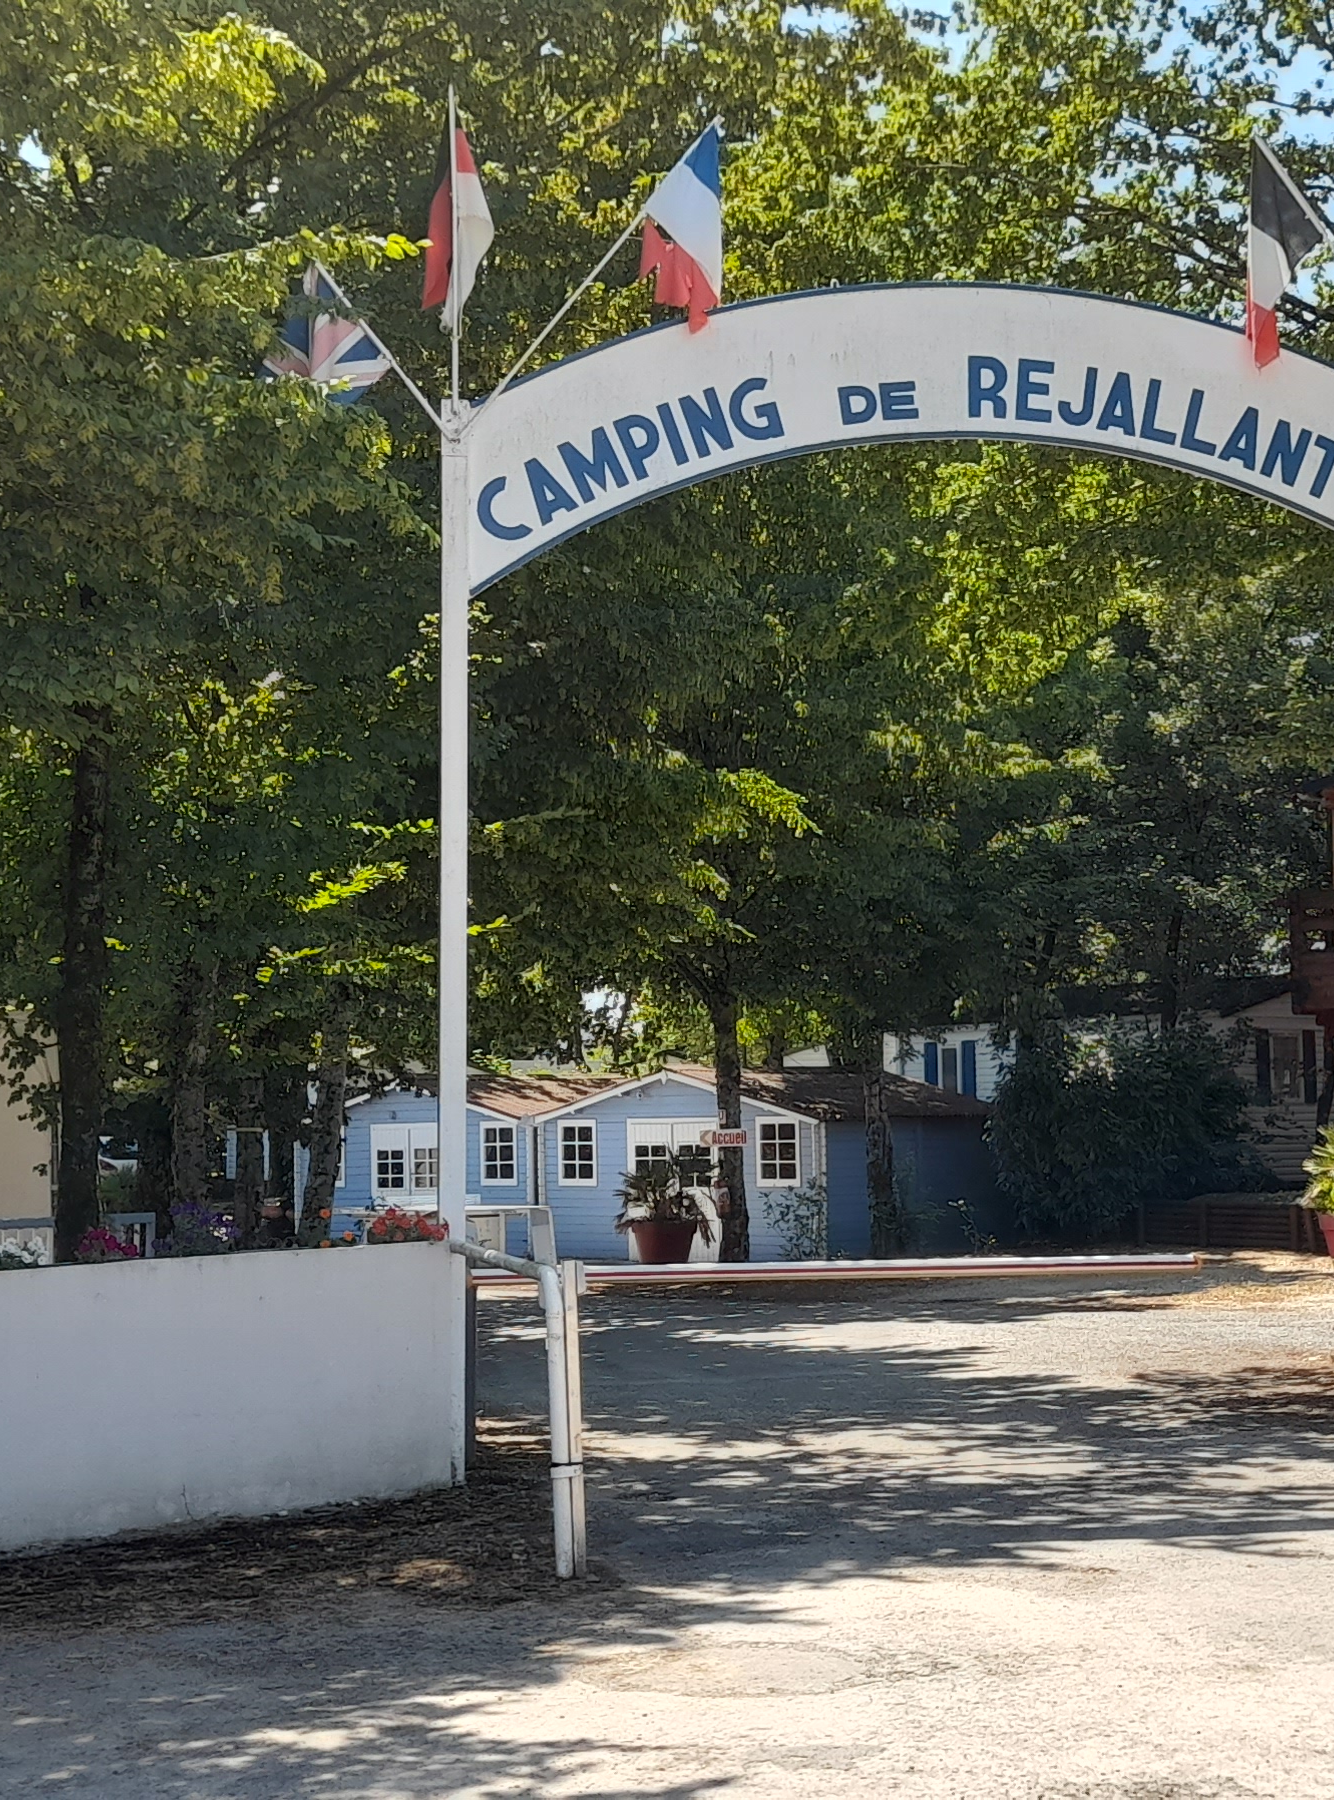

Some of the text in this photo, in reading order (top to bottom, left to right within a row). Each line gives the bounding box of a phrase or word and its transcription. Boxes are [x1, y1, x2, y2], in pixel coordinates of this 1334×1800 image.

[477, 378, 784, 540] CAMPING
[837, 381, 919, 425] DE
[712, 1130, 746, 1144] Accueil
